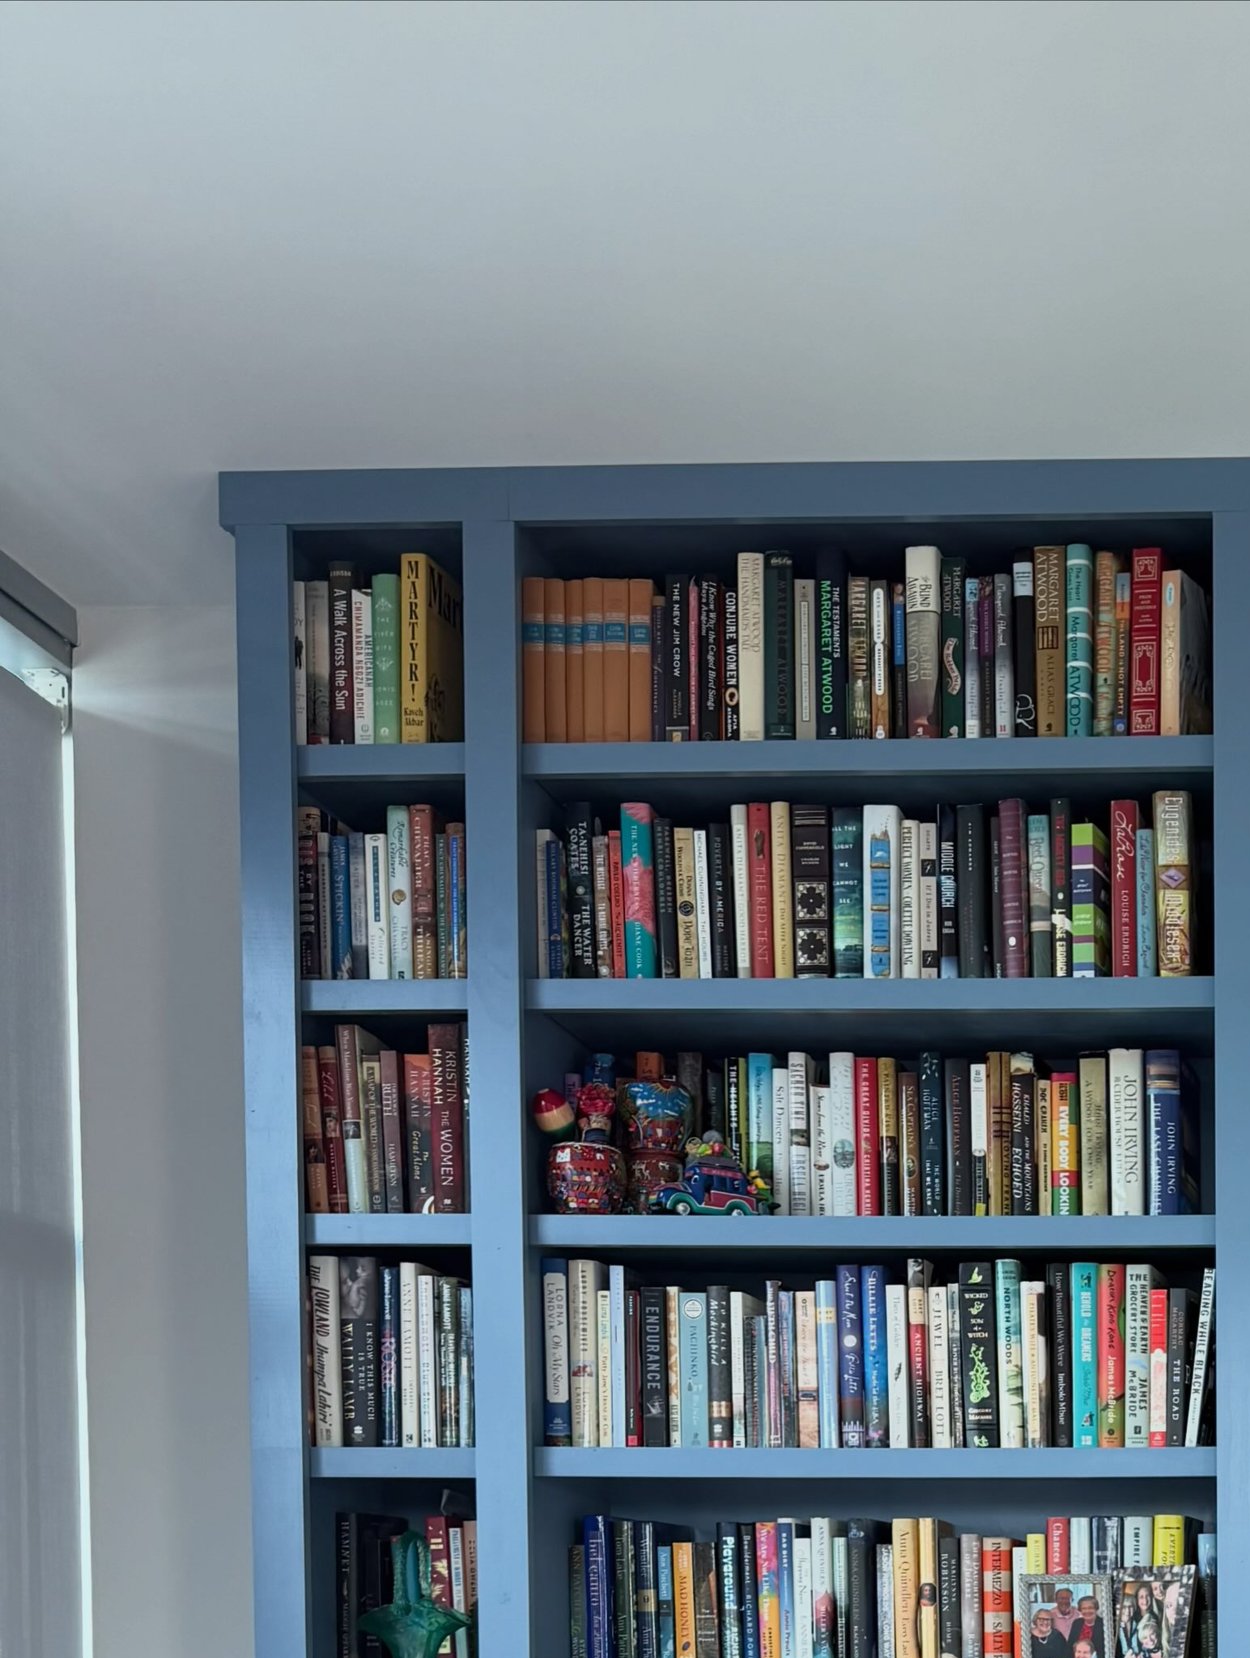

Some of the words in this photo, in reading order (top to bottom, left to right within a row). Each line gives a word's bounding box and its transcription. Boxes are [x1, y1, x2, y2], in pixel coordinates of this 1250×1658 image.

[1037, 553, 1047, 622] ATWOOD
[1049, 553, 1059, 622] MARGARET
[334, 600, 346, 625] Walk
[408, 561, 419, 702] MARTYR!
[726, 592, 736, 640] CONJURE
[820, 580, 831, 651] MARGARET
[335, 629, 346, 666] Across
[726, 645, 737, 685] WOMEN
[335, 669, 347, 686] the
[821, 656, 832, 714] ATWOOD
[336, 690, 348, 710] Sun
[1162, 797, 1183, 862] Eugenides
[570, 829, 579, 870] COATES
[940, 841, 954, 873] MIDDLE
[755, 865, 766, 892] THE
[941, 875, 955, 908] CHURCH
[582, 905, 590, 925] THE
[756, 897, 766, 923] RED
[1121, 890, 1129, 923] LOUISE
[573, 914, 583, 957] DANCER
[582, 929, 592, 965] WATER
[757, 927, 768, 964] TENT
[432, 1048, 443, 1105] HANNAH
[445, 1050, 456, 1103] KRISTIN
[1012, 1082, 1021, 1133] HOSSEINI
[1124, 1075, 1138, 1122] JOHN
[441, 1110, 449, 1127] THE
[1058, 1106, 1070, 1137] EVERY
[440, 1128, 454, 1187] WOMEN
[1013, 1147, 1022, 1199] ECHOED
[1059, 1140, 1070, 1168] BODY
[1125, 1127, 1138, 1184] IRVING
[311, 1286, 330, 1338] LOWLAND
[1004, 1287, 1012, 1323] NORTH
[645, 1306, 660, 1390] ENDURANCE
[708, 1298, 718, 1366] Mockingbird
[1005, 1326, 1013, 1365] WOODS
[1196, 1321, 1208, 1355] WHILE
[315, 1339, 329, 1387] Jhumpa
[1107, 1354, 1116, 1385] James
[1173, 1358, 1181, 1383] THE
[1192, 1359, 1203, 1396] BLACK
[1057, 1373, 1067, 1401] Imbolo
[1107, 1386, 1117, 1424] McBride
[1172, 1388, 1180, 1422] ROAD
[319, 1389, 332, 1427] Lahiri
[1058, 1401, 1066, 1426] Mbue
[1053, 1523, 1063, 1560] Chances
[722, 1536, 737, 1610] Playground
[941, 1552, 950, 1612] ROBINSON
[992, 1541, 1002, 1605] INTERMEZZO
[992, 1621, 1003, 1652] SALLY
